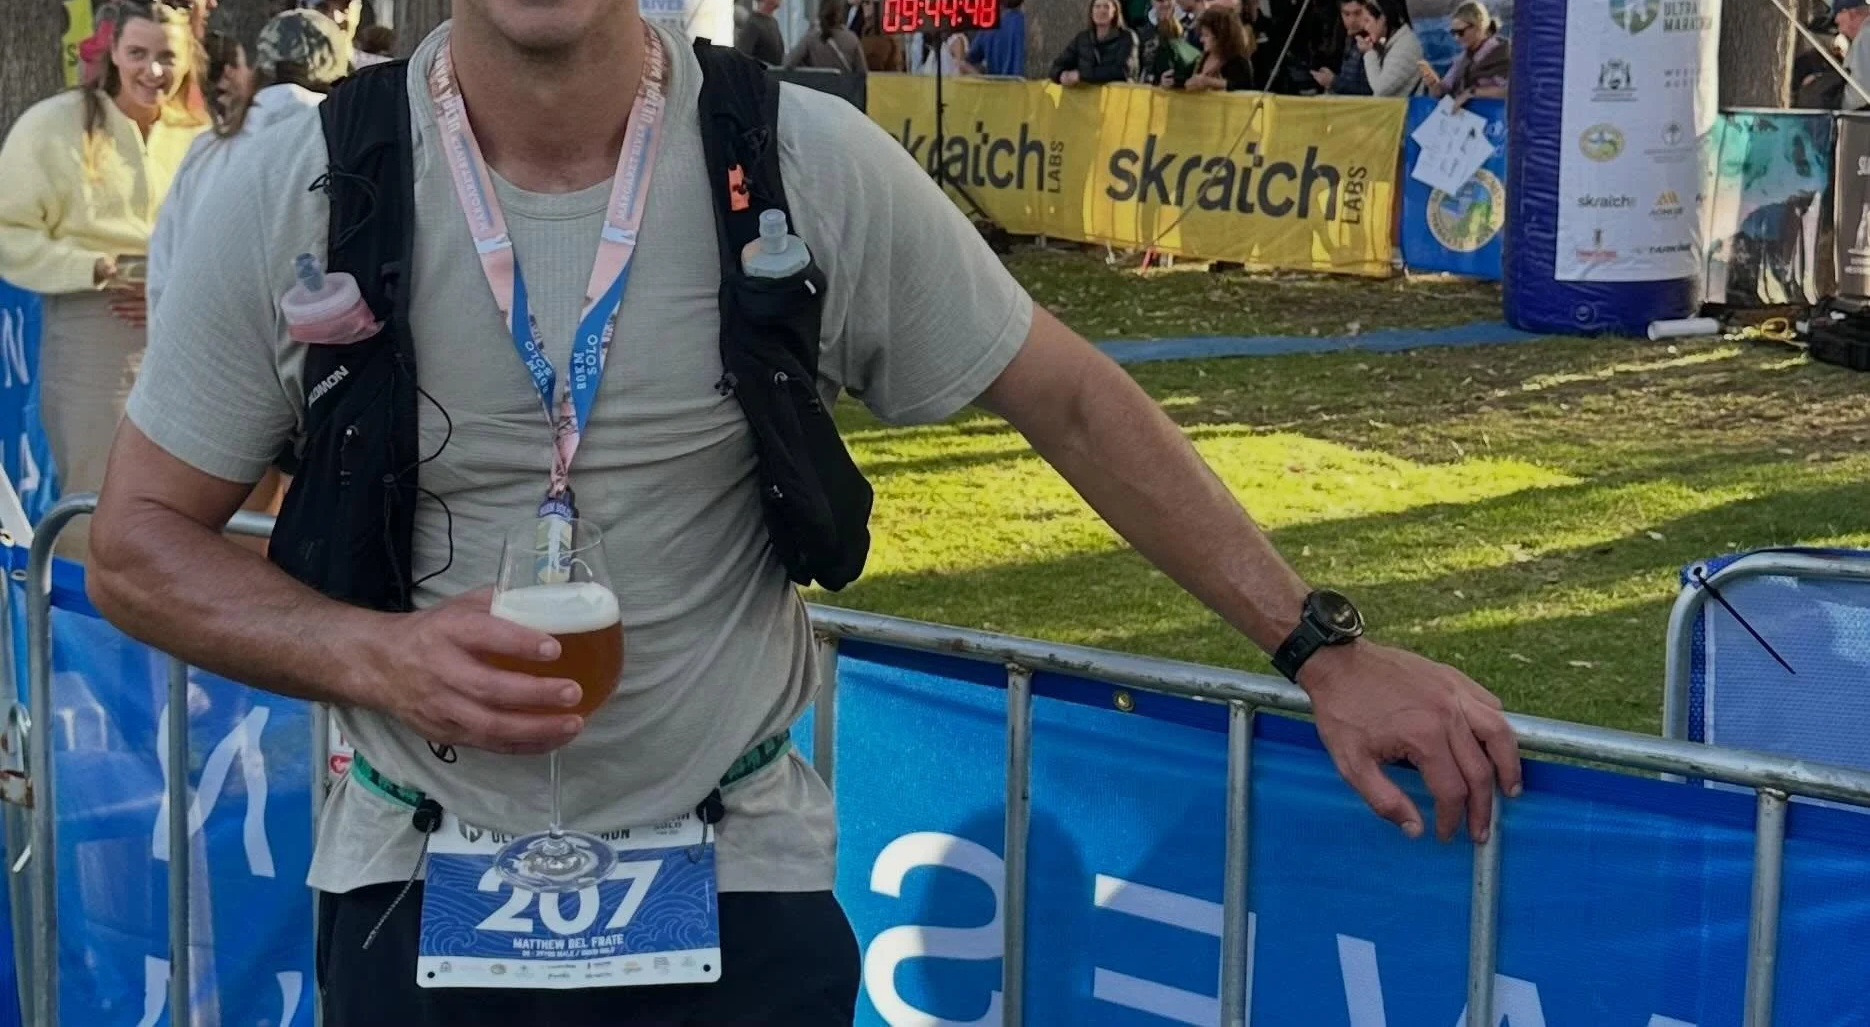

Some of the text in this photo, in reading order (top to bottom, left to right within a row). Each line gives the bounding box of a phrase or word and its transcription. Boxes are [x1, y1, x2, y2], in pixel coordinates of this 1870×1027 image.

[640, 77, 662, 124] ULTRA
[1047, 139, 1065, 194] LABS
[1105, 134, 1341, 222] skratch
[1341, 164, 1368, 226] LABS
[585, 333, 599, 376] SOLO
[475, 859, 663, 935] 207
[512, 937, 566, 950] MATTHEW
